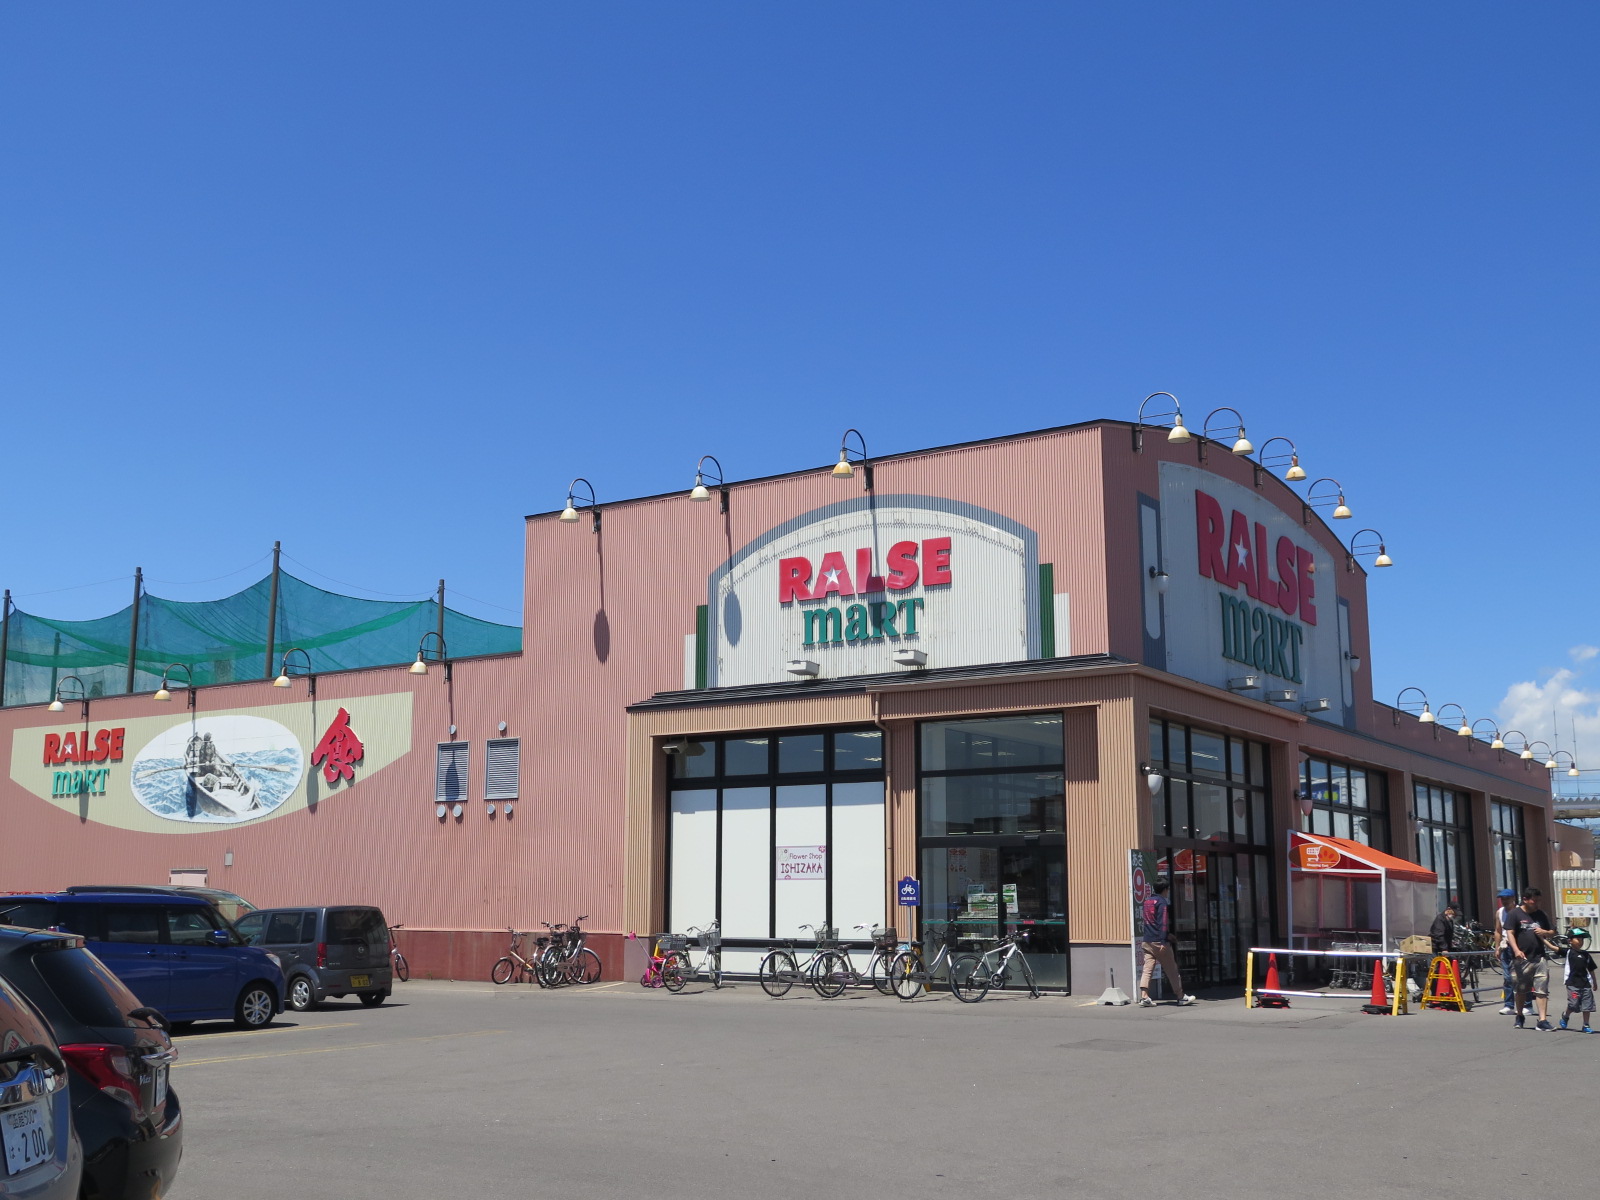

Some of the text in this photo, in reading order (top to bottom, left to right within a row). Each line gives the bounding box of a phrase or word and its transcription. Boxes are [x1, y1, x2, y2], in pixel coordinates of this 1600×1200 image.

[779, 536, 952, 603] RALSE
[1195, 489, 1317, 627] RALSE
[43, 727, 125, 764] RALSE
[780, 862, 824, 874] ISHIZAKA
[789, 852, 823, 861] Flower Shop
